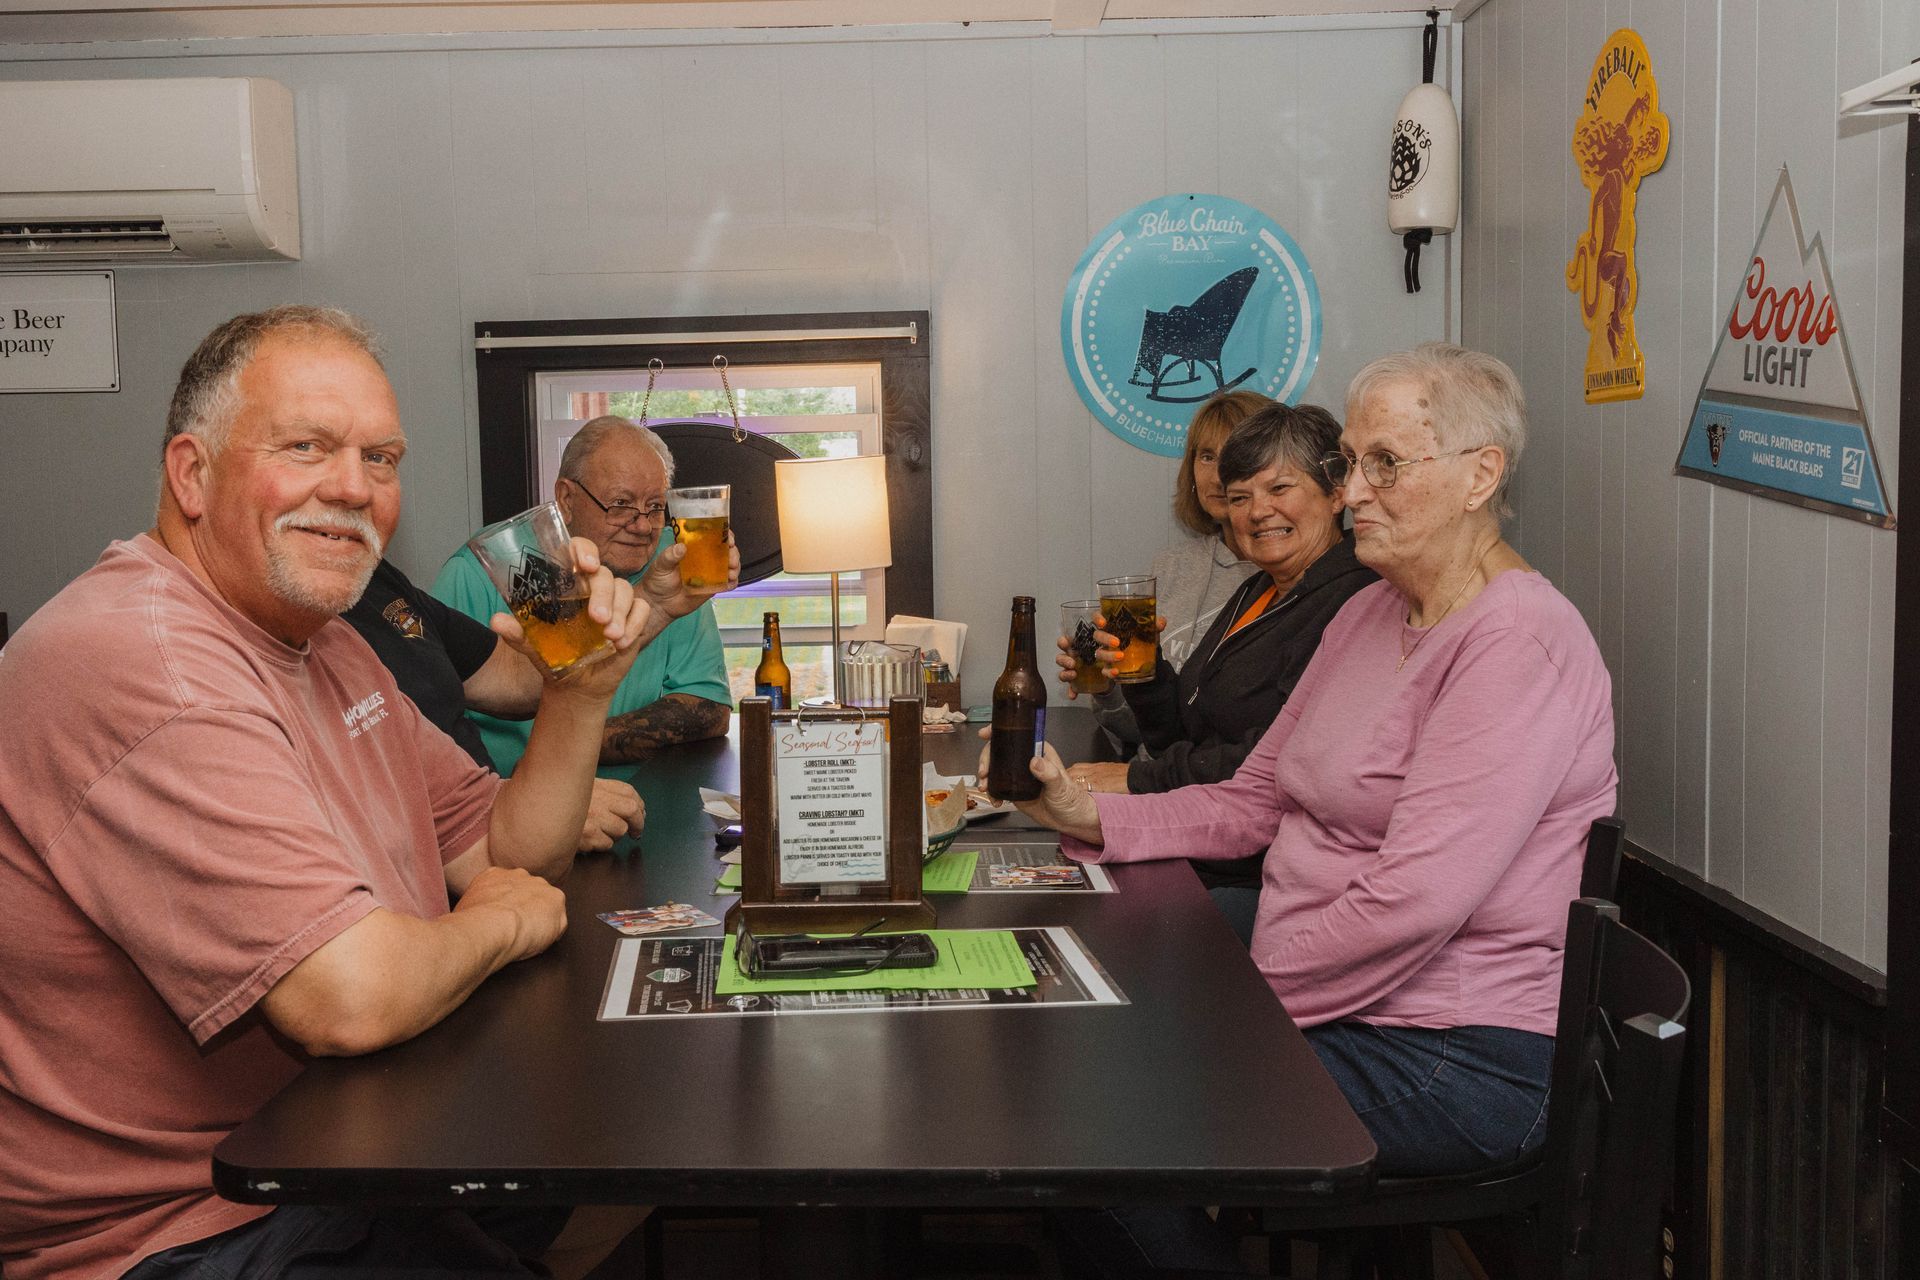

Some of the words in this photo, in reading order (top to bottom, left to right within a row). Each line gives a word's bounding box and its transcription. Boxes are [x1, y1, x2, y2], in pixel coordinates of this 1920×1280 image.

[1588, 45, 1642, 114] FIREBALL
[1137, 208, 1188, 239] Blue
[1190, 207, 1249, 236] Chair
[1171, 235, 1213, 252] BAY
[1728, 256, 1839, 346] Coors
[12, 308, 65, 330] Beer
[0, 339, 55, 358] pany
[1743, 343, 1814, 388] LIGHT
[1738, 429, 1769, 446] OFFICIAL
[1770, 435, 1804, 453] PARTNER
[1804, 441, 1815, 455] OF
[1815, 444, 1832, 458] THE
[1752, 452, 1776, 467] MAINE
[1776, 456, 1799, 473] BLACK
[1799, 461, 1824, 478] BEARS
[1843, 450, 1863, 476] 21
[781, 731, 832, 754] Seasonal
[835, 729, 880, 754] Seafood
[827, 759, 840, 767] ROLL
[798, 810, 821, 819] CRAVING
[848, 809, 865, 817] (MKT)
